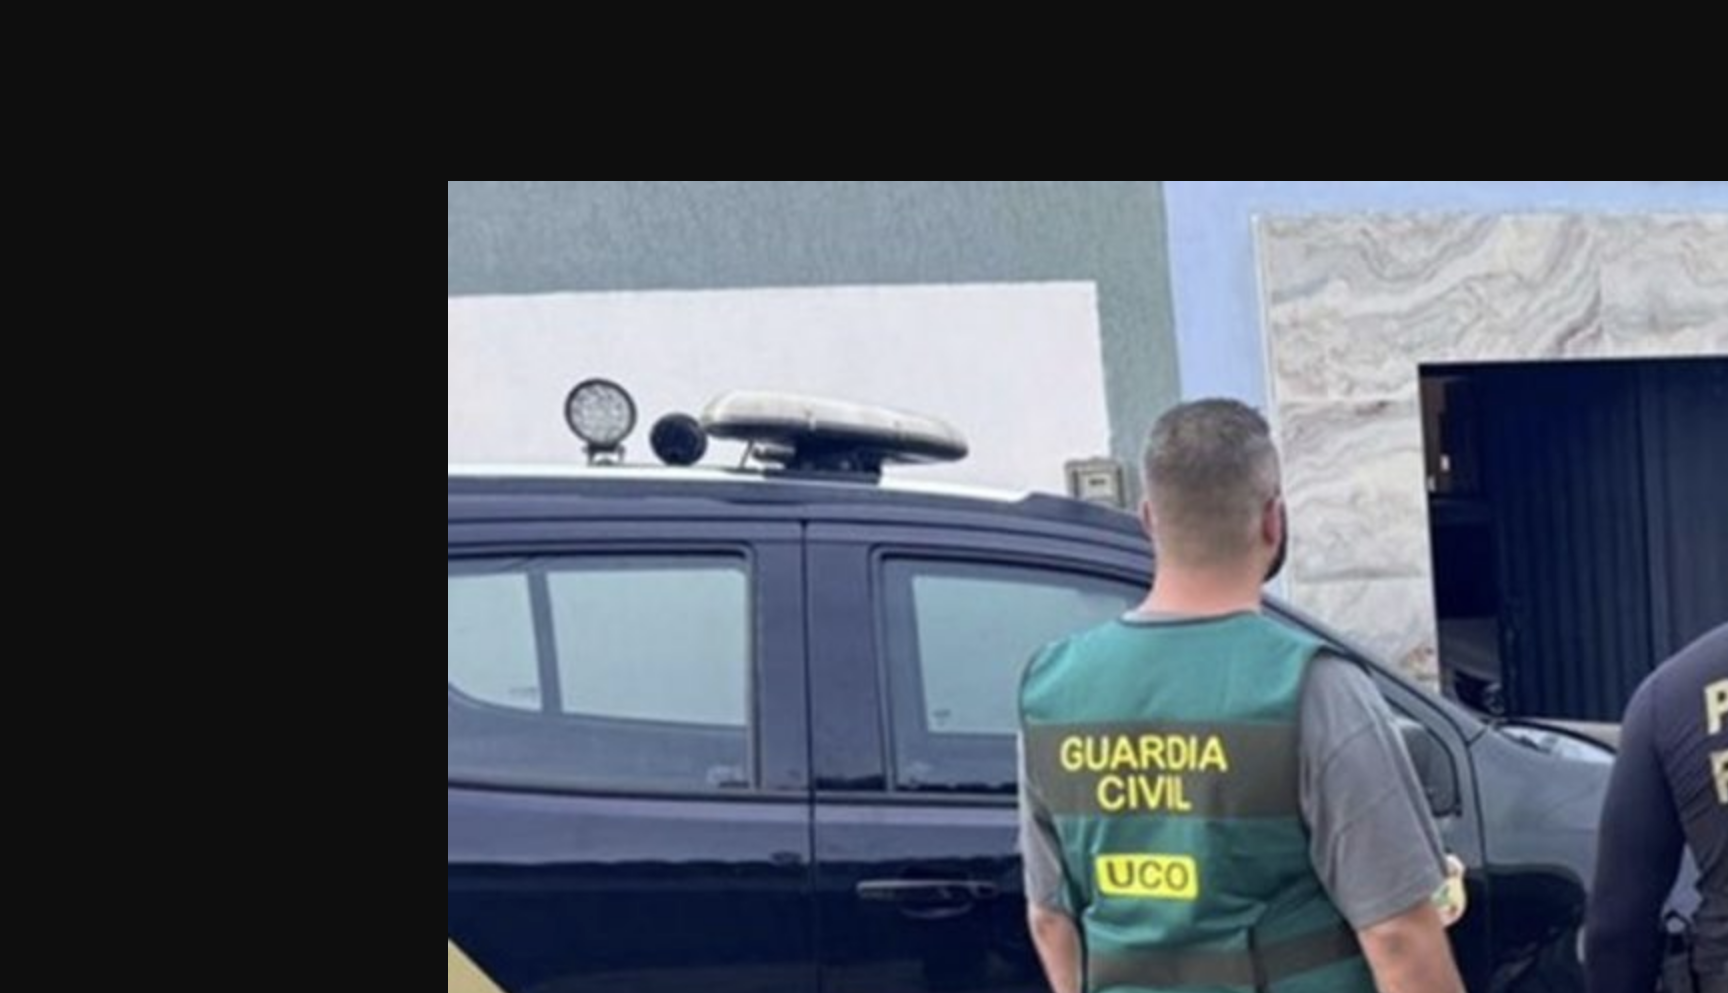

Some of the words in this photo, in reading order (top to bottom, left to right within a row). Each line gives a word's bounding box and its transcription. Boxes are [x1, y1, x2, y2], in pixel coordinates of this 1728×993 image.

[1059, 736, 1228, 771] GUARDIA
[1097, 776, 1193, 810] CIVIL
[1107, 860, 1190, 891] UCO
